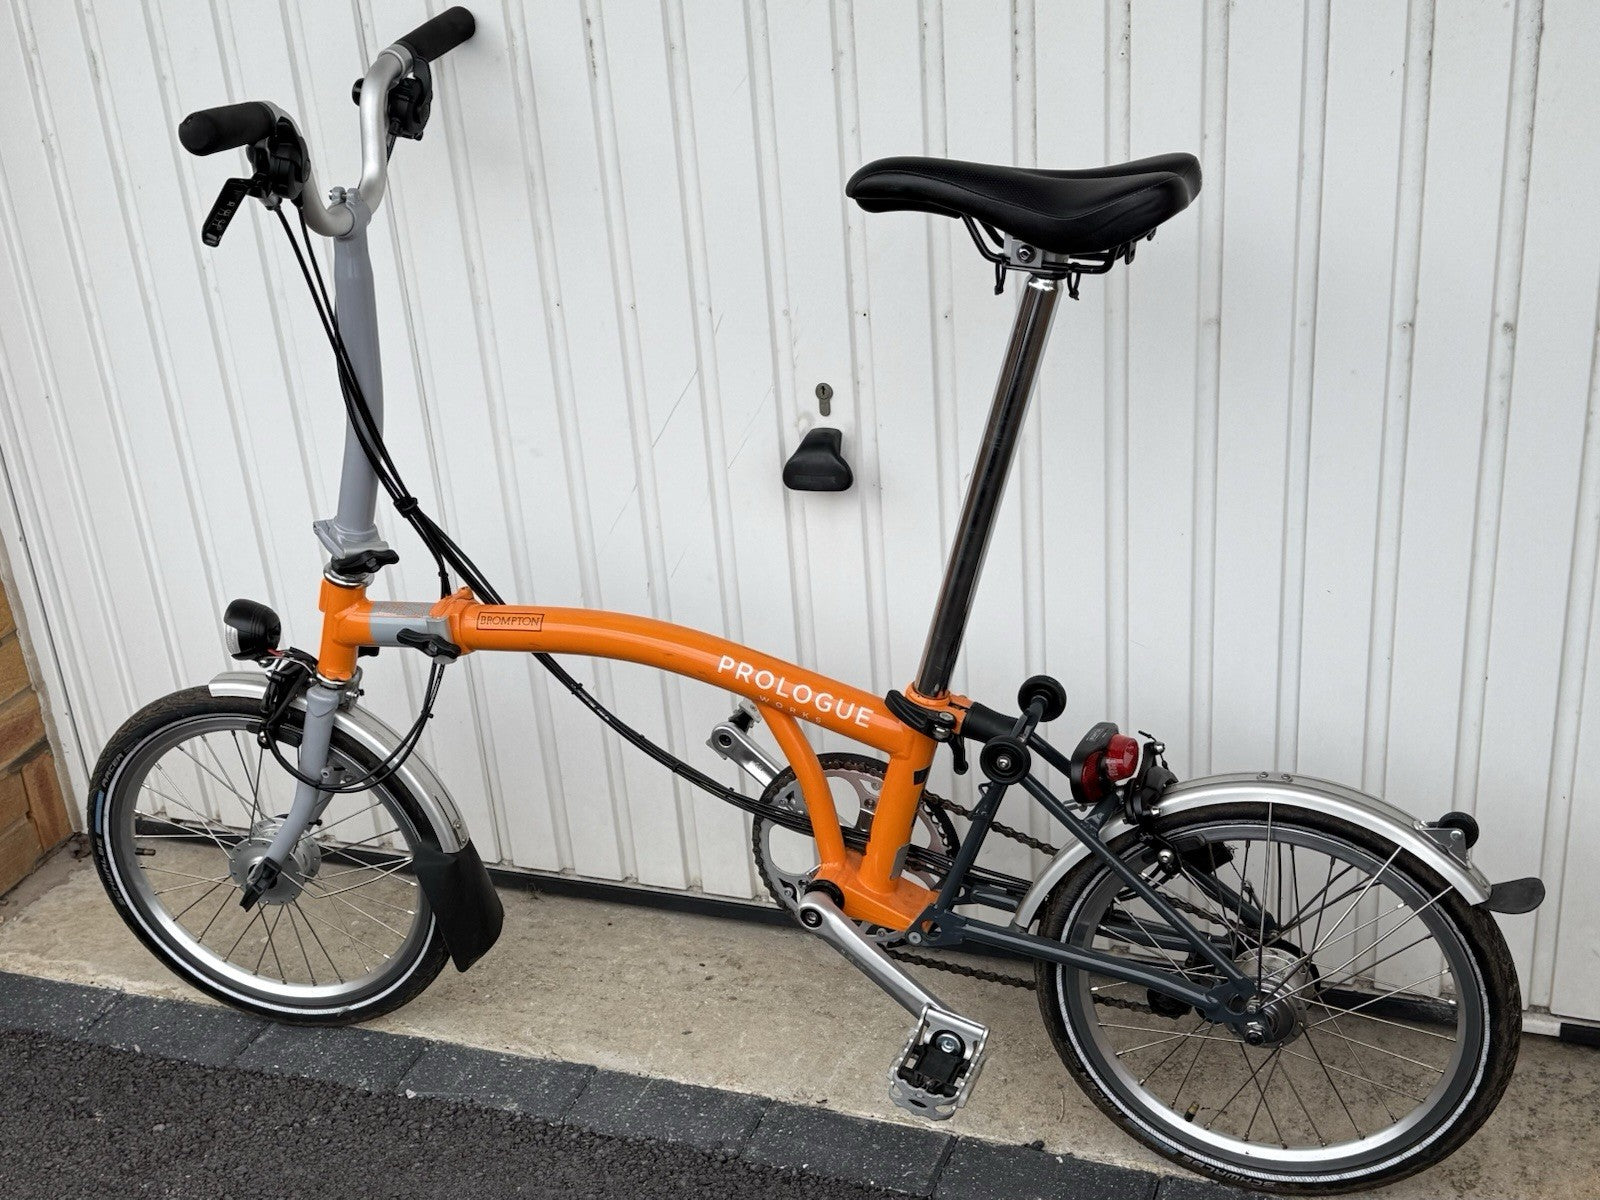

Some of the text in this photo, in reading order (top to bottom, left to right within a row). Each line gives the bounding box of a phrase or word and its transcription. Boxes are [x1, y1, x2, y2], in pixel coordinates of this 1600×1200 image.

[480, 615, 541, 626] BROMPTON
[717, 655, 874, 729] PROLOGUE
[758, 695, 822, 724] WORKS
